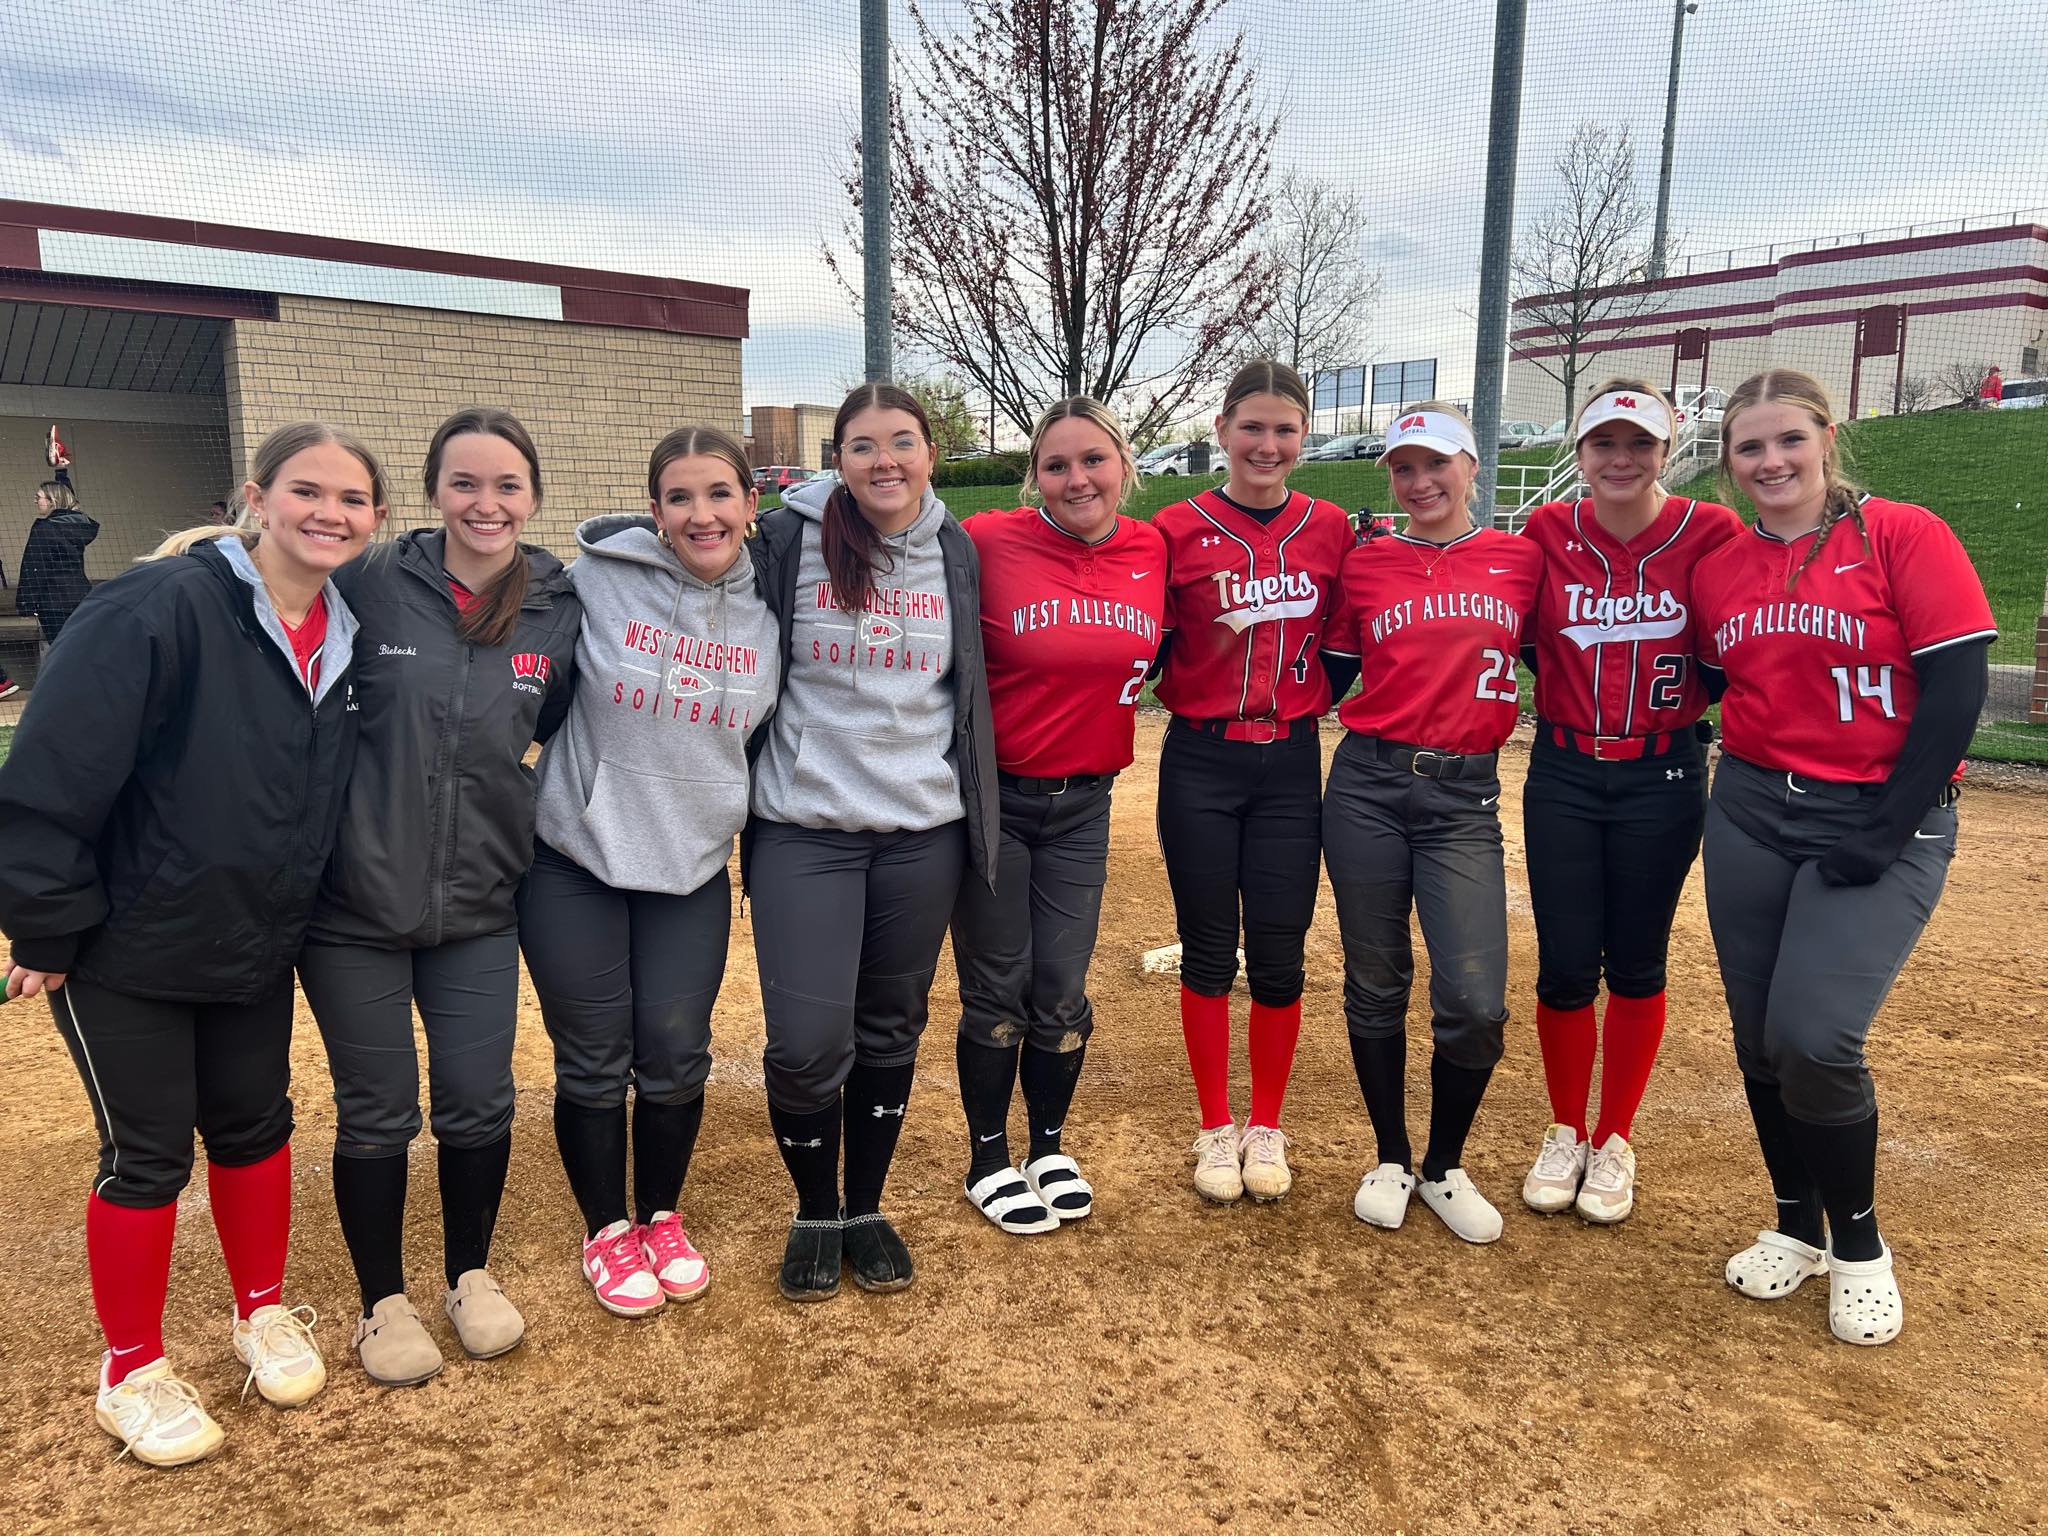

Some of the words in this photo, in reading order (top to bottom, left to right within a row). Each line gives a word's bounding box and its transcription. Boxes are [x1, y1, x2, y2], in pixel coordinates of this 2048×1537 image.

[1211, 569, 1319, 613] Tigers
[1564, 583, 1687, 631] Tigers
[871, 625, 891, 637] WA
[1012, 599, 1060, 636] WEST
[1069, 598, 1157, 646] ALLEGHENY
[1371, 599, 1413, 645] WEST
[1422, 592, 1520, 639] ALLEGHENY
[1751, 602, 1866, 651] ALLEGHENY
[378, 643, 417, 656] Bielecki
[511, 652, 551, 685] WA
[671, 634, 758, 676] ALLEGHENY
[1289, 632, 1315, 684] 4
[680, 677, 700, 690] WA
[1830, 664, 1897, 722] 14
